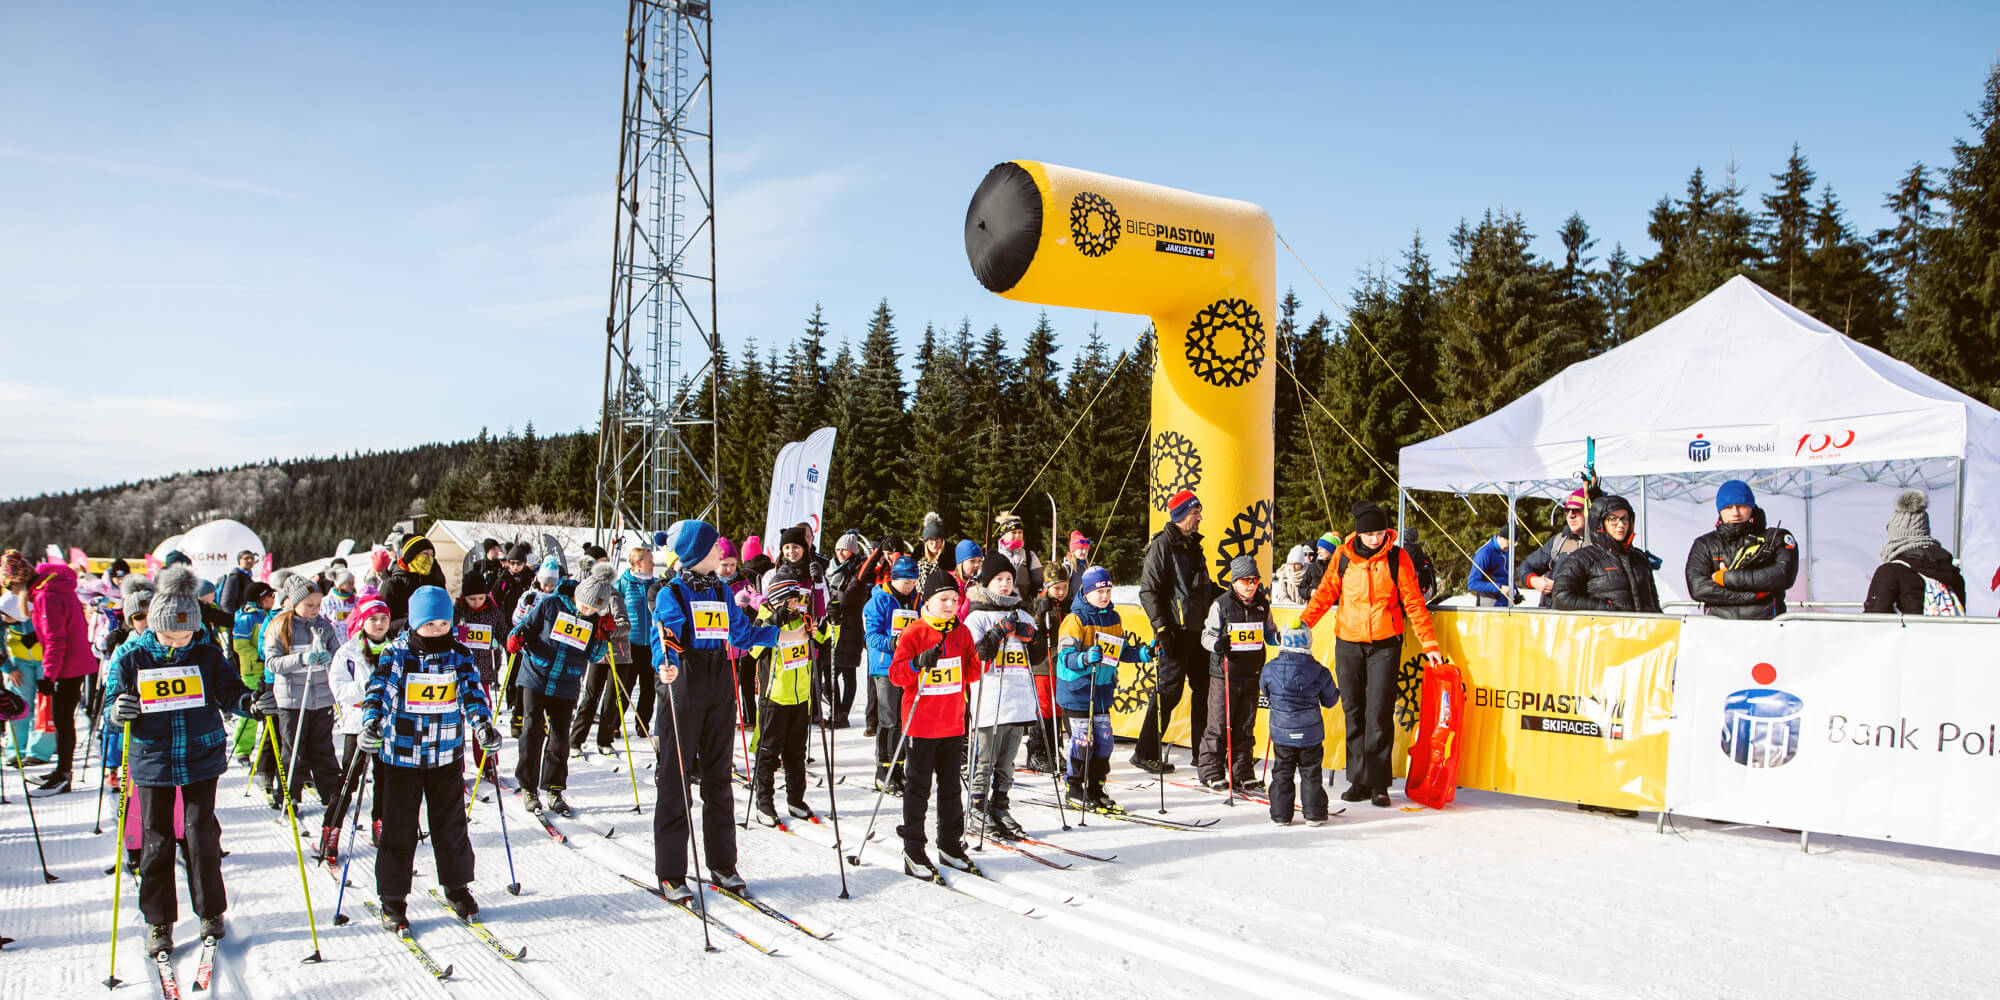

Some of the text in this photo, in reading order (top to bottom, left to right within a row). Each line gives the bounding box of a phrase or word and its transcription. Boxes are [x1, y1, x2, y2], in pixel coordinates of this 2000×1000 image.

[1127, 219, 1215, 246] BIEGPIASTÓW
[1165, 243, 1205, 257] JAKUSZYCE
[1718, 443, 1742, 454] Bank
[1746, 441, 1775, 453] Polski
[704, 612, 723, 627] 71
[466, 630, 484, 641] 30
[564, 623, 583, 638] 81
[1238, 630, 1256, 642] 64
[791, 644, 806, 659] 24
[1103, 641, 1115, 656] 74
[1006, 651, 1024, 664] 62
[931, 668, 952, 683] 51
[155, 678, 186, 697] 80
[421, 685, 449, 701] 47
[1541, 718, 1599, 736] SKIRACES
[1827, 714, 2000, 757] Bank Pol
